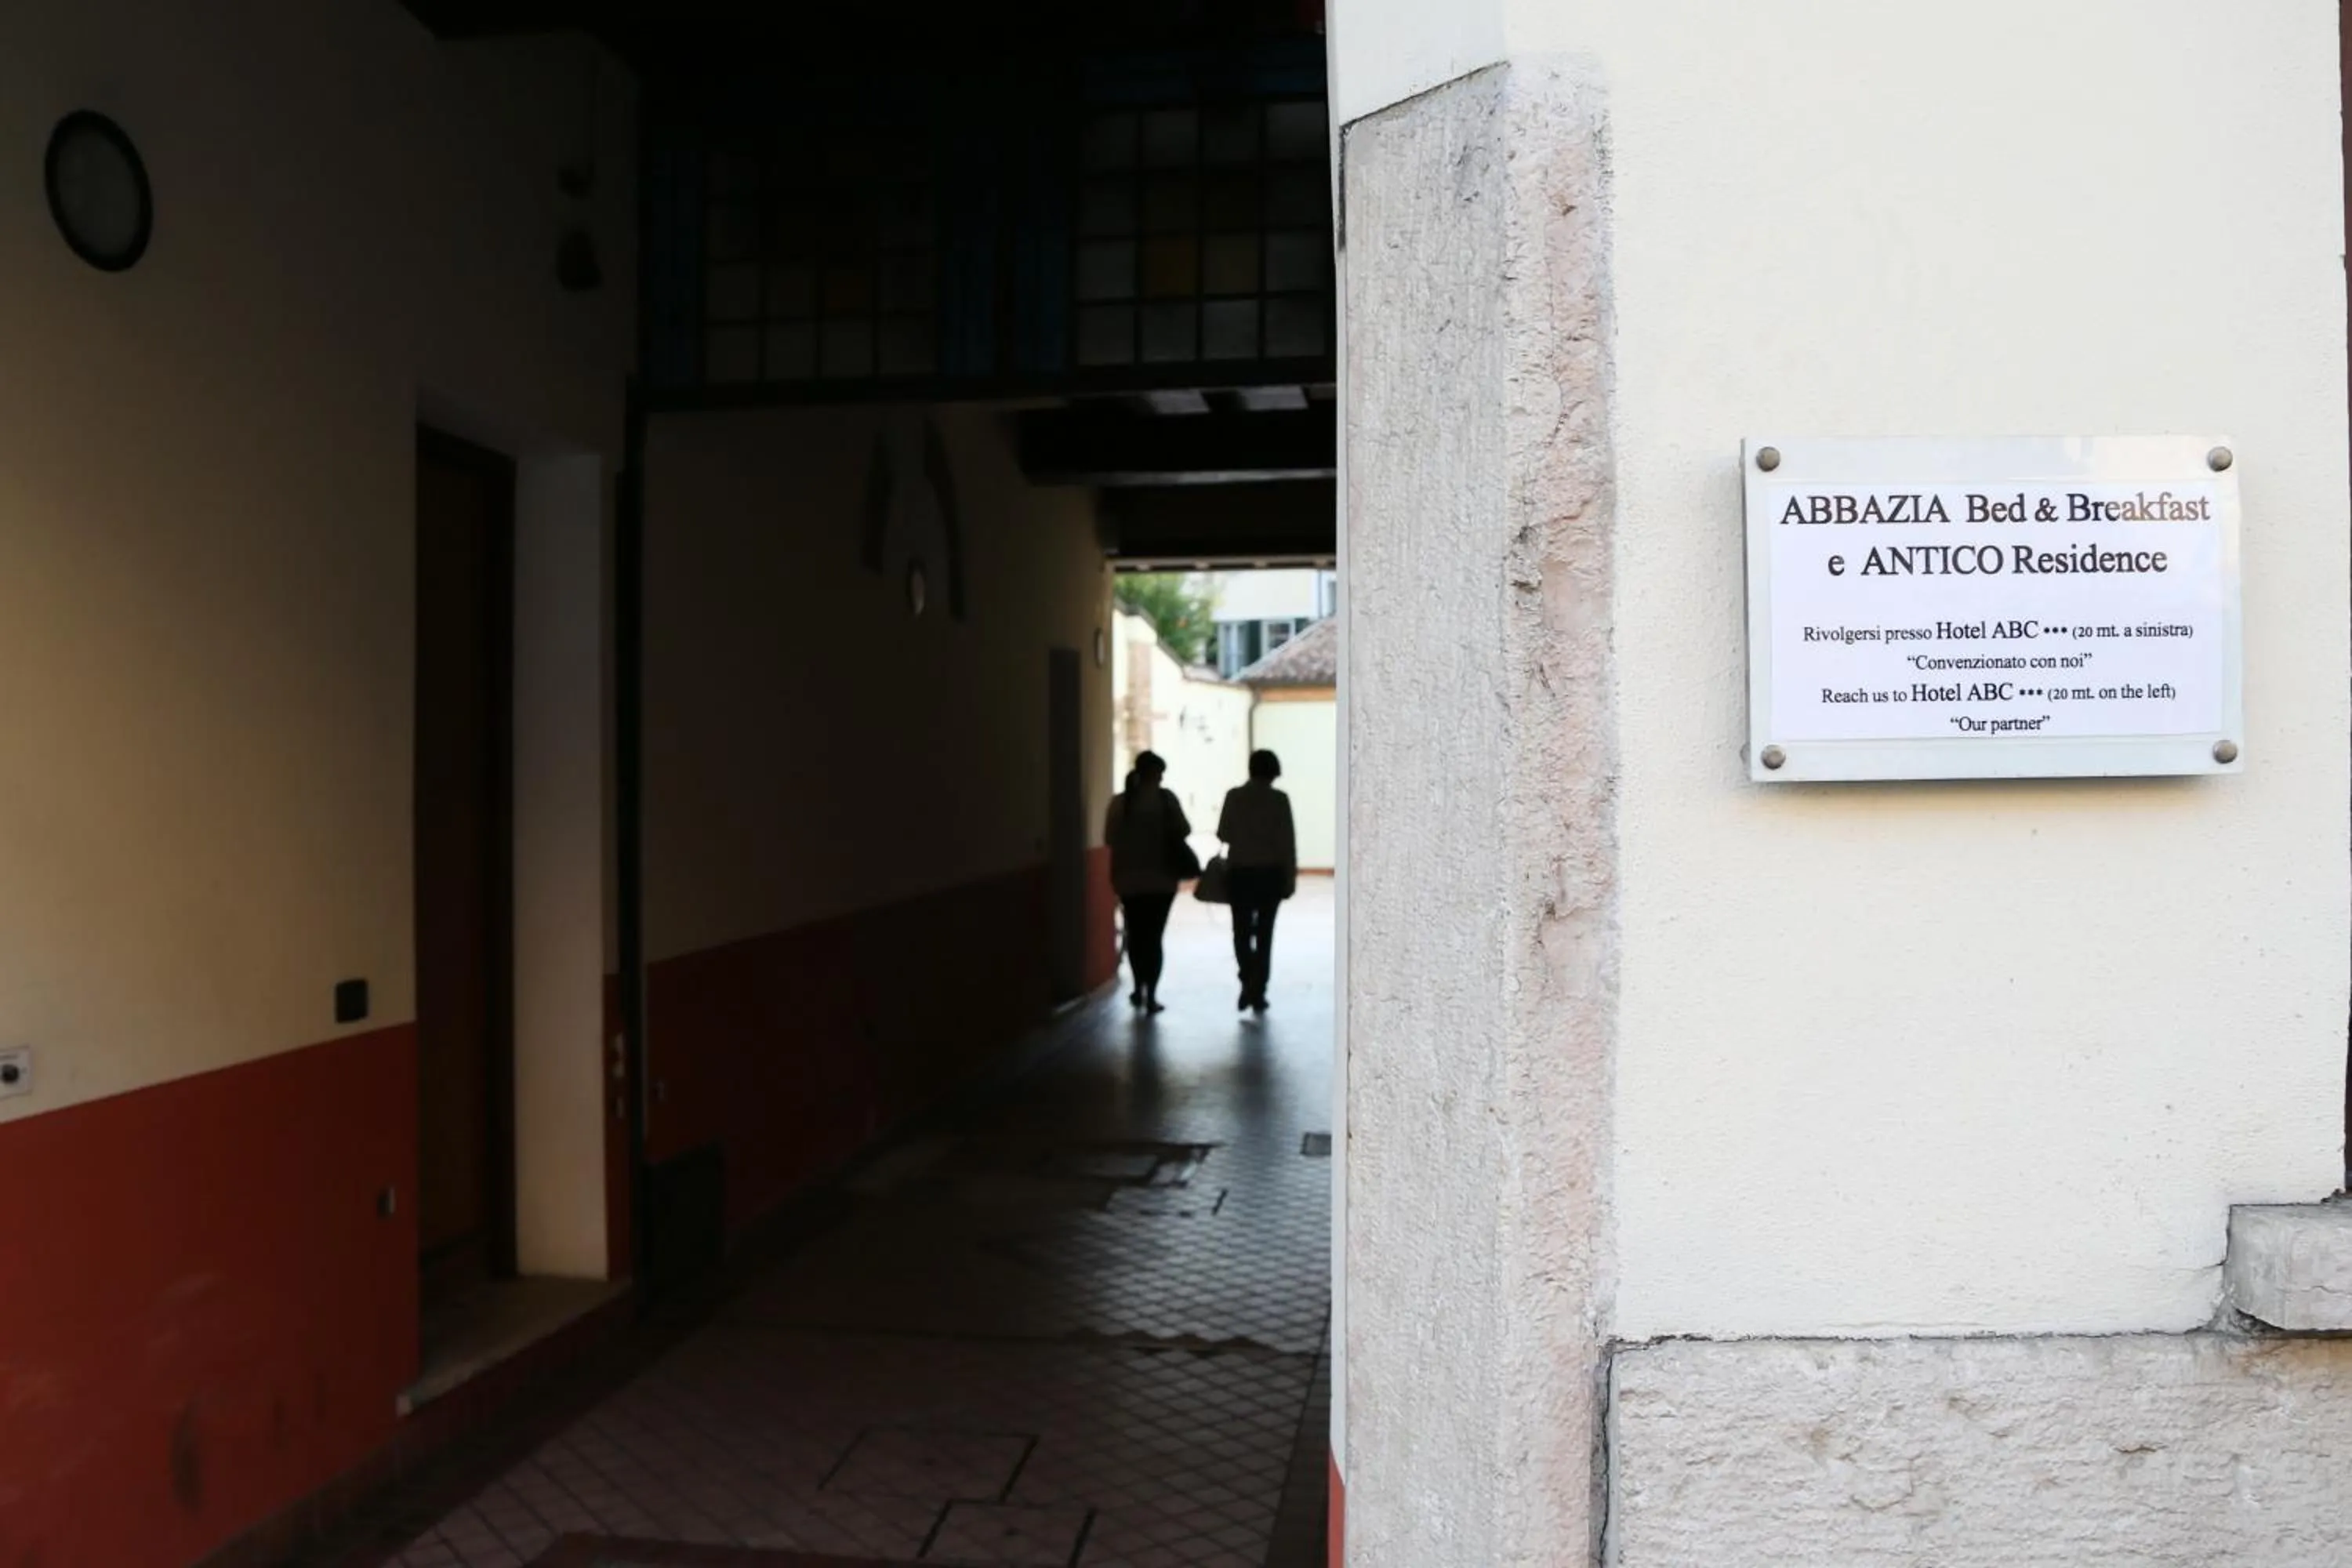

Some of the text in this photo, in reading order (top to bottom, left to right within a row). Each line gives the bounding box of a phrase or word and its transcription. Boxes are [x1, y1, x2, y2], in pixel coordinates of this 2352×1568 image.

[1779, 491, 2211, 525] ABBAZIA Bed & Breakfast
[1828, 543, 2168, 577] e ANTICO Residence
[1803, 619, 2194, 645] Rivolgersi presso Hotel ABC (20 mt. a sinistra)
[2029, 656, 2057, 669] con
[1821, 681, 2176, 703] Reach us to Hotel ABC (20 mt. on the left)
